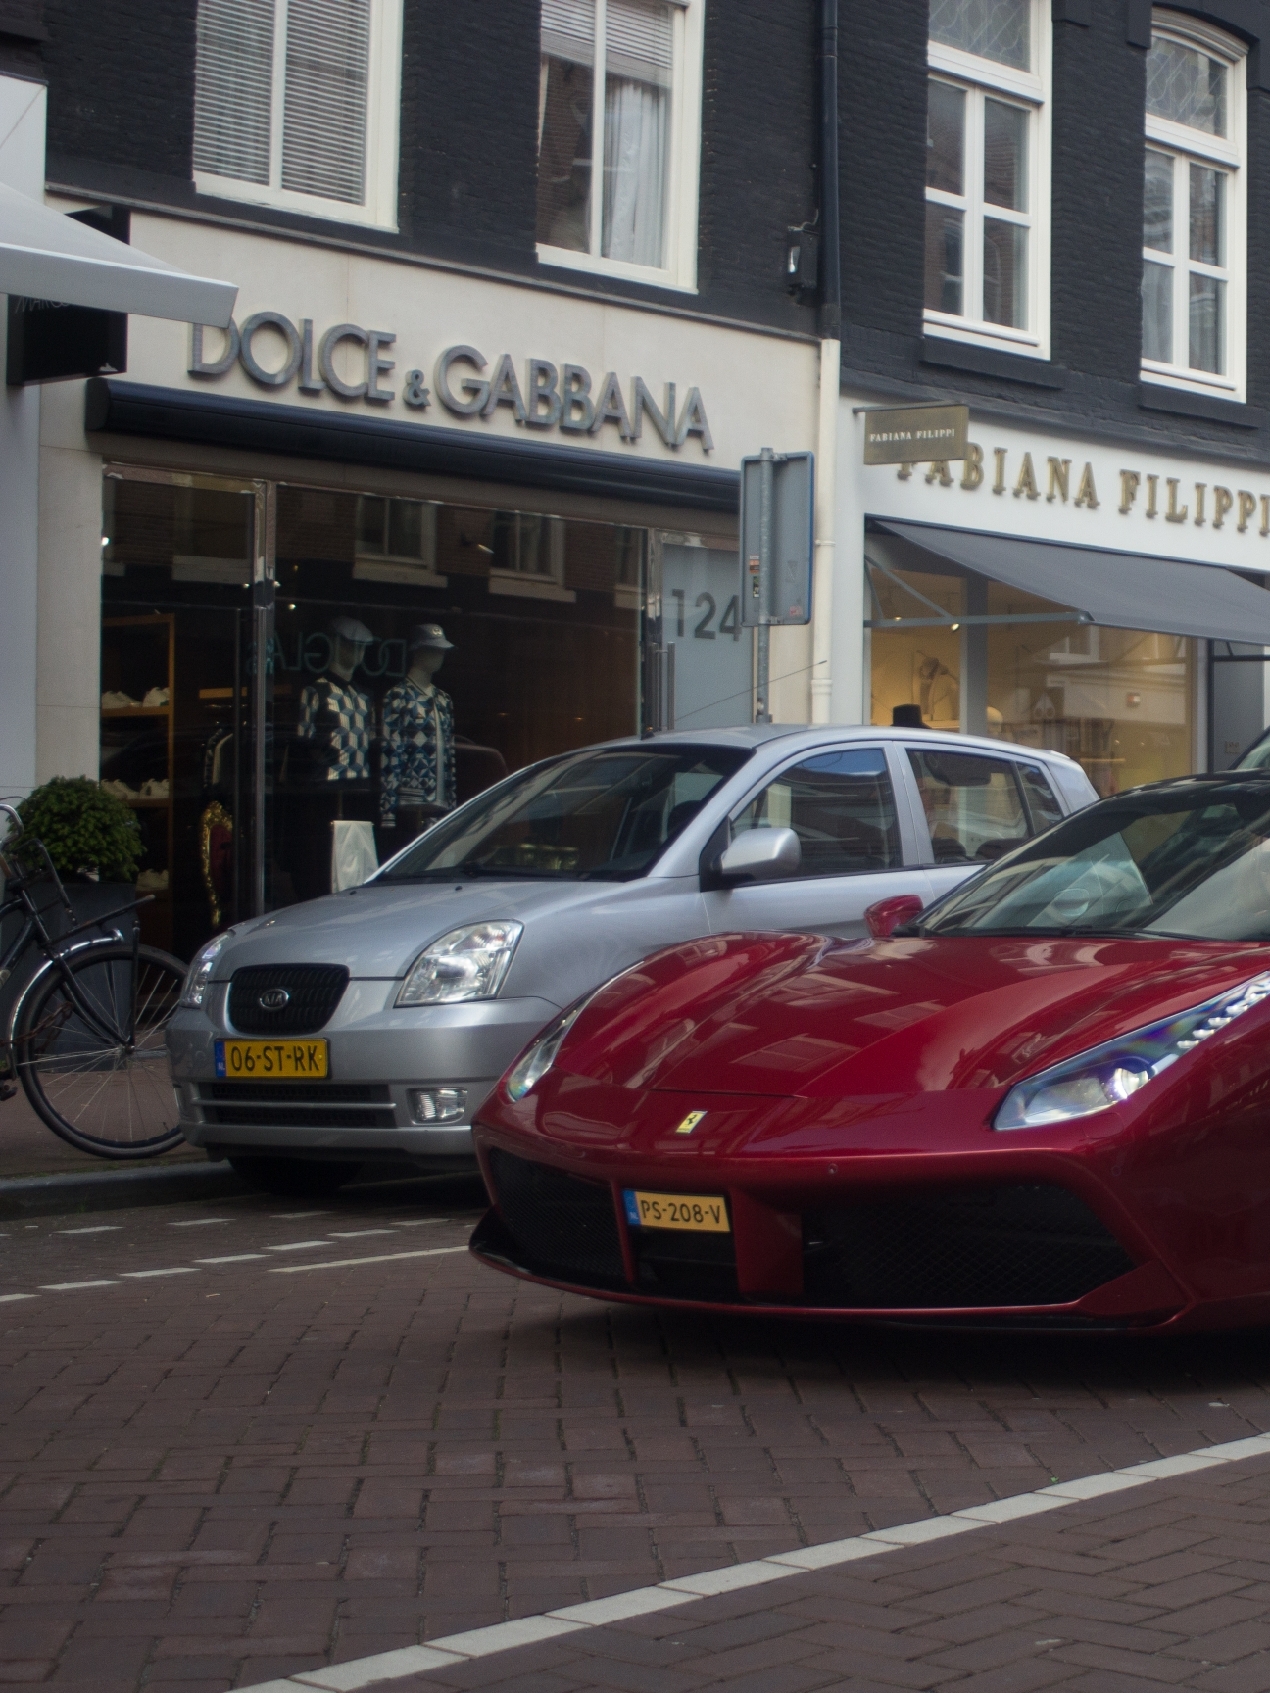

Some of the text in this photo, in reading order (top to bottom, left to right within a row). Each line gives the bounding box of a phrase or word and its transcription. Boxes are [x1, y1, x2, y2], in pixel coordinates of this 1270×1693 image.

[187, 311, 715, 452] DOLCE & GABBANA
[869, 428, 955, 443] FABIANA FILIPPI
[671, 588, 742, 642] 124
[231, 1045, 320, 1072] 06-ST-RK
[641, 1199, 721, 1224] PS-208-V
